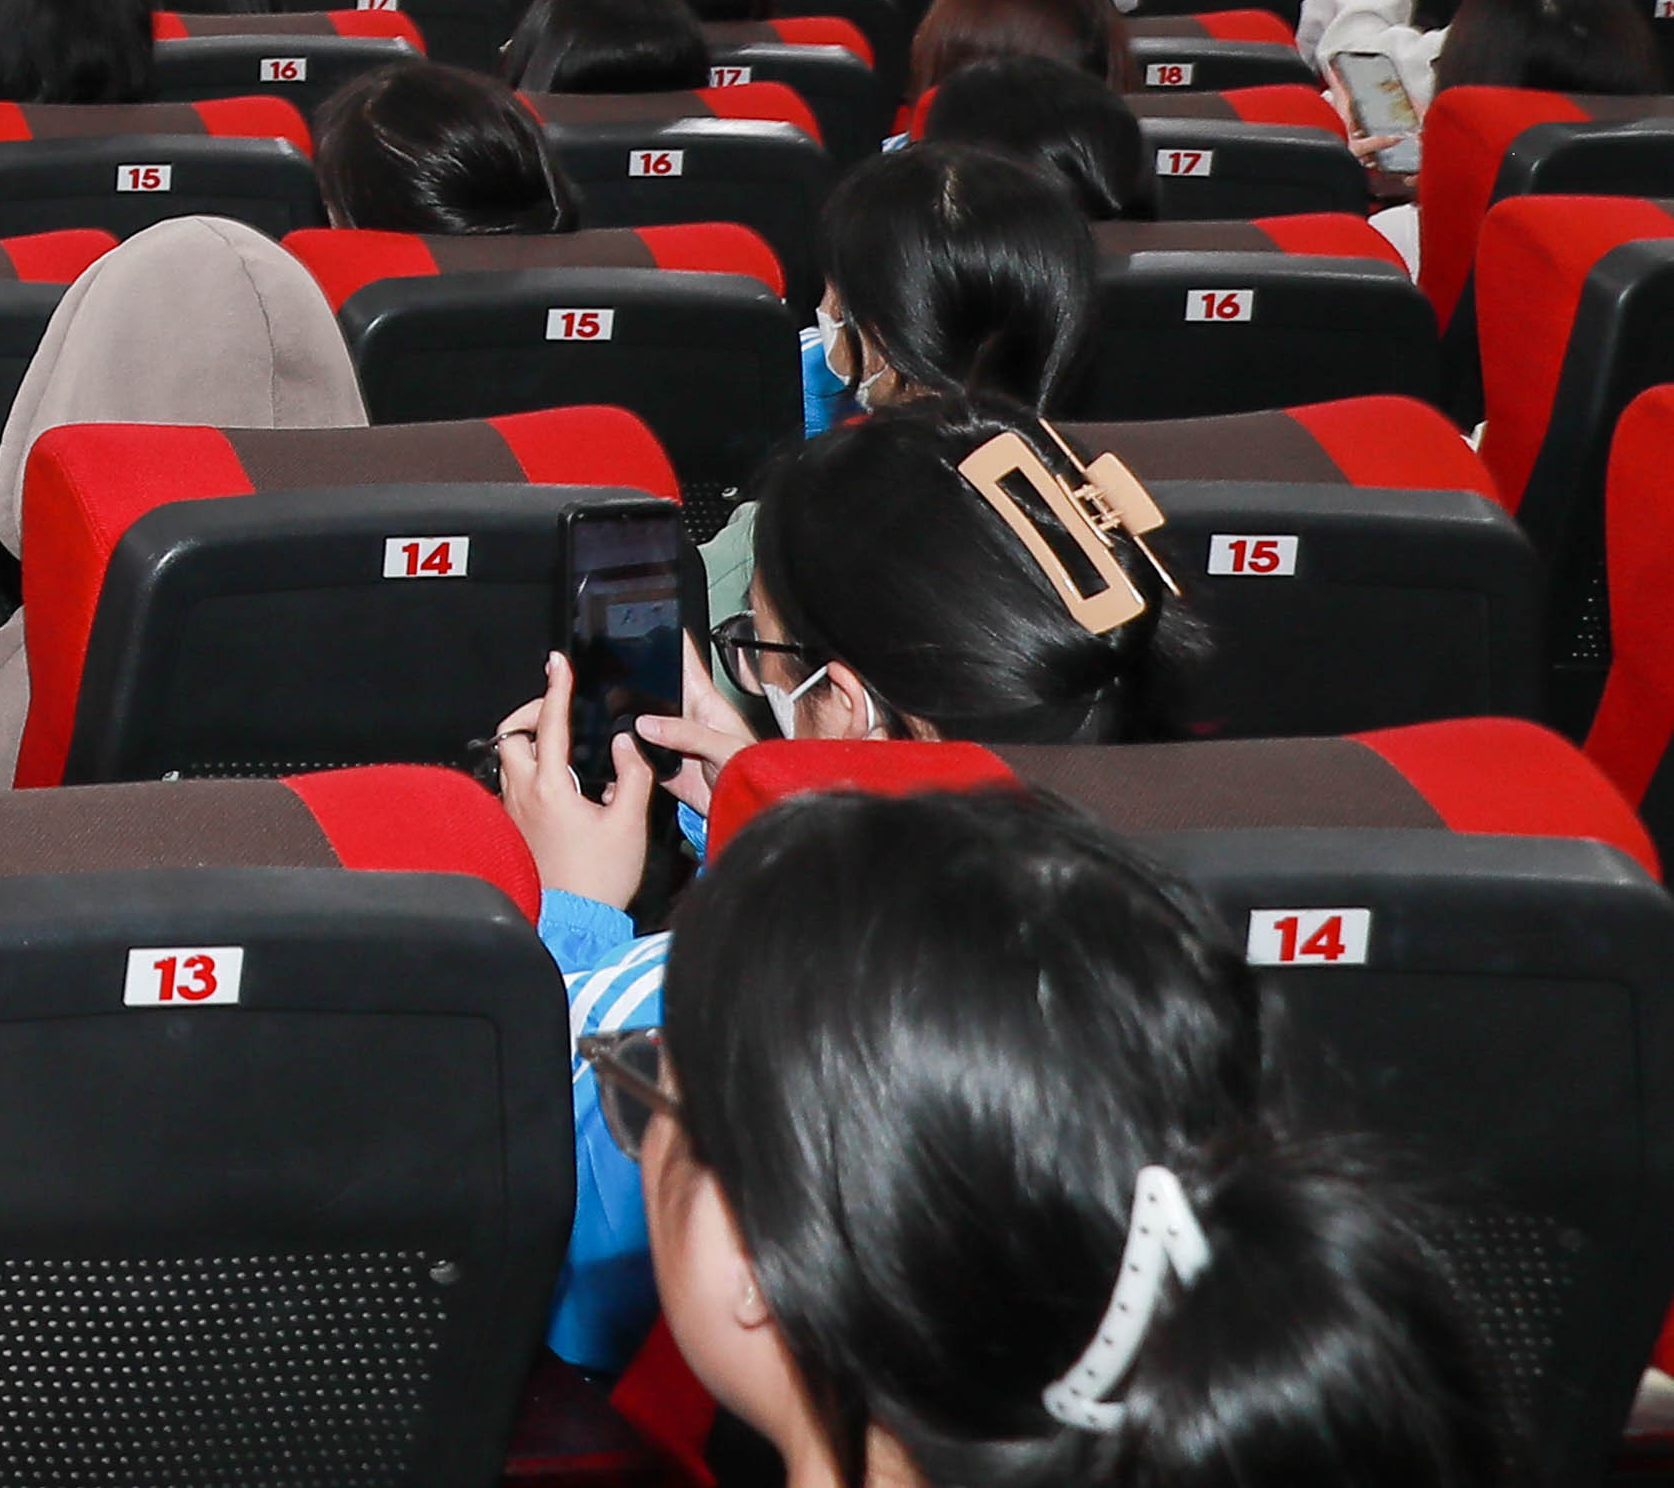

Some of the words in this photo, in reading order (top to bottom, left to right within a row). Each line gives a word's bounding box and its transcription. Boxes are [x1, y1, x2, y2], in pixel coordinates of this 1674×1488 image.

[271, 61, 299, 80] 16
[715, 69, 743, 87] 17
[1159, 66, 1183, 85] 18
[641, 152, 673, 175] 16
[1169, 152, 1202, 174] 17
[129, 168, 161, 190] 15
[1202, 293, 1240, 320] 16
[563, 312, 600, 338] 15
[403, 542, 453, 576] 14
[1230, 540, 1280, 573] 15
[1275, 916, 1346, 962] 14
[155, 954, 218, 1002] 13
